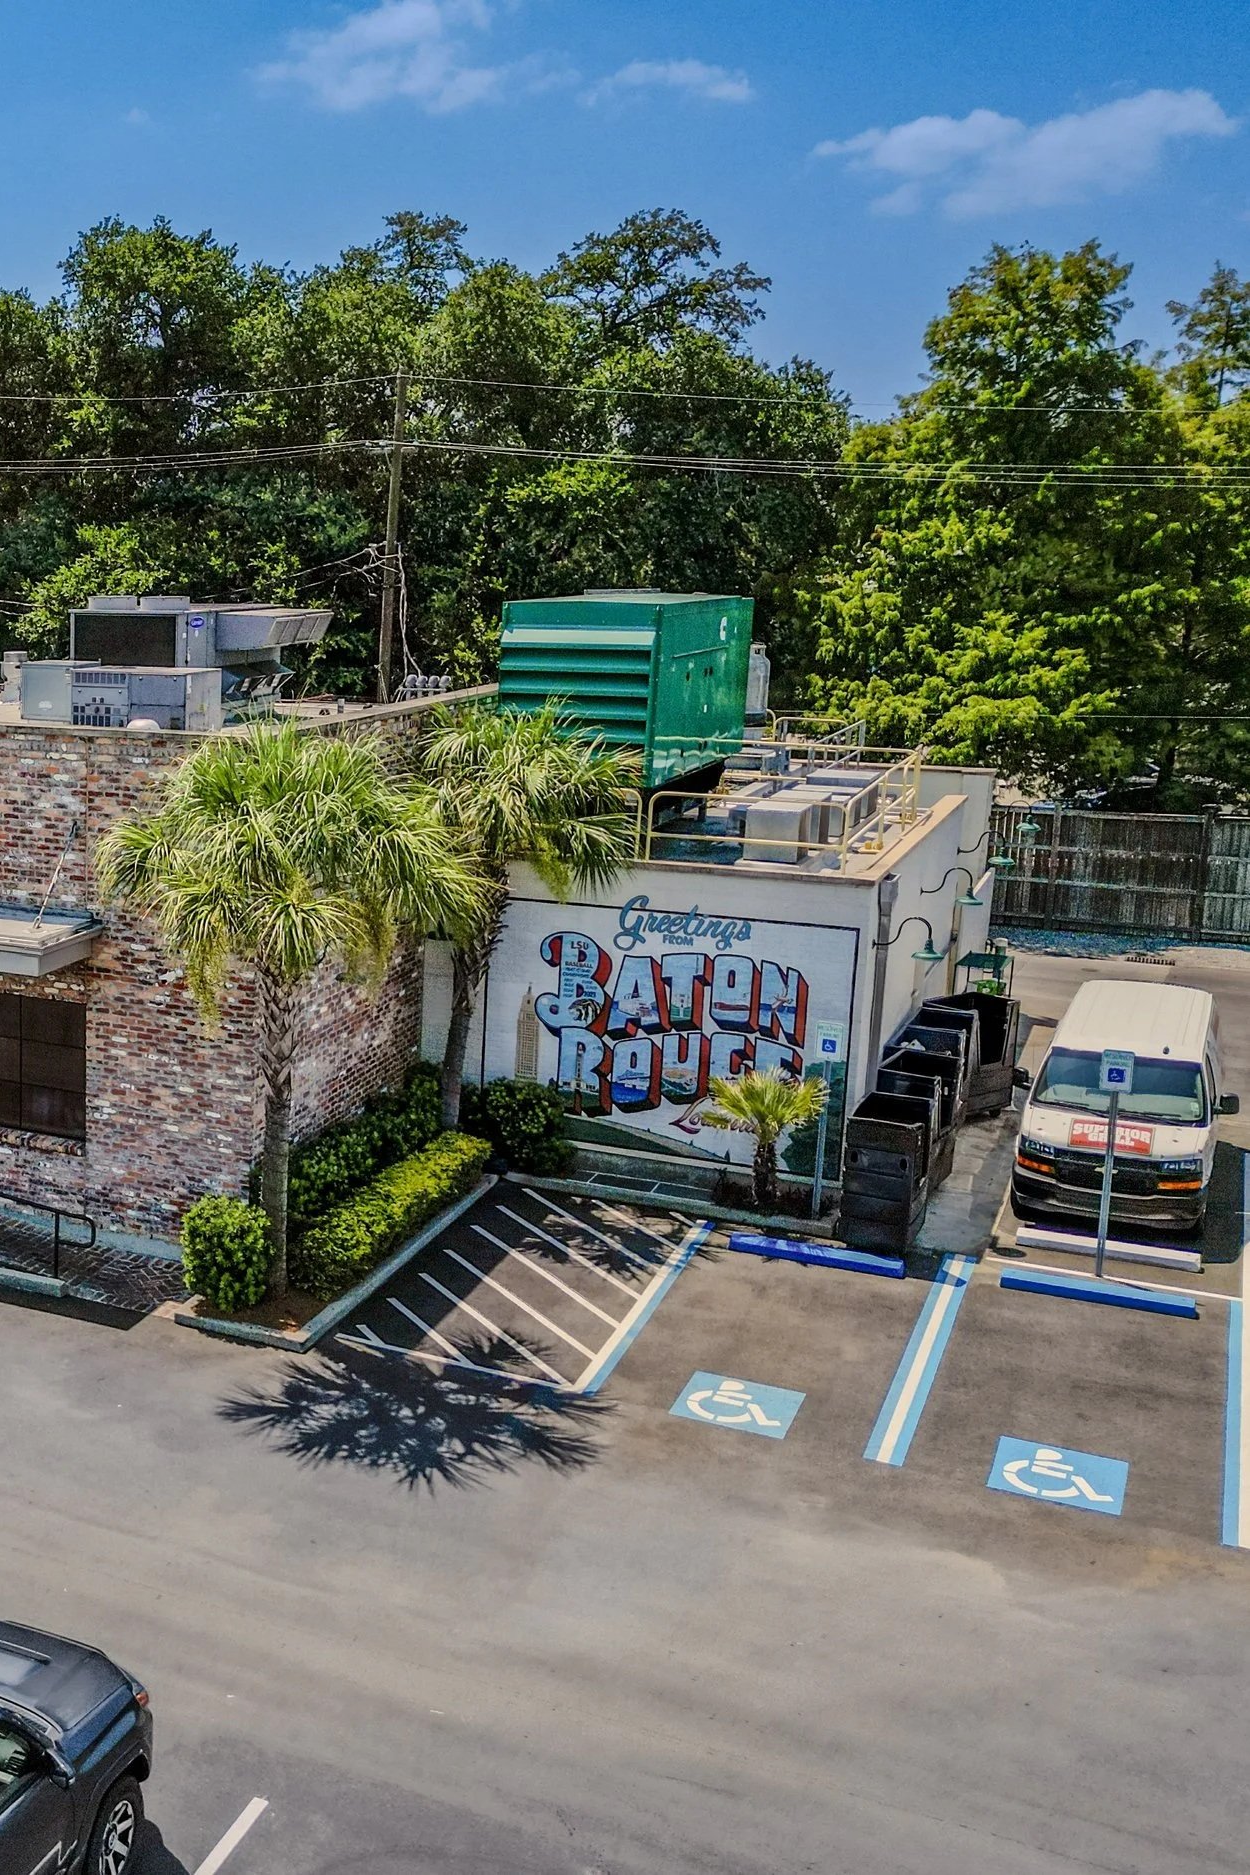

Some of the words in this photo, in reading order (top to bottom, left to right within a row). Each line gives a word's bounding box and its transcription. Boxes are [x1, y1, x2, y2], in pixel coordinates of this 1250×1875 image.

[613, 895, 751, 951] Greetings
[571, 941, 589, 950] LSU
[662, 934, 694, 946] FROM
[534, 931, 808, 1049] BATON
[1087, 1132, 1135, 1146] GRLL
